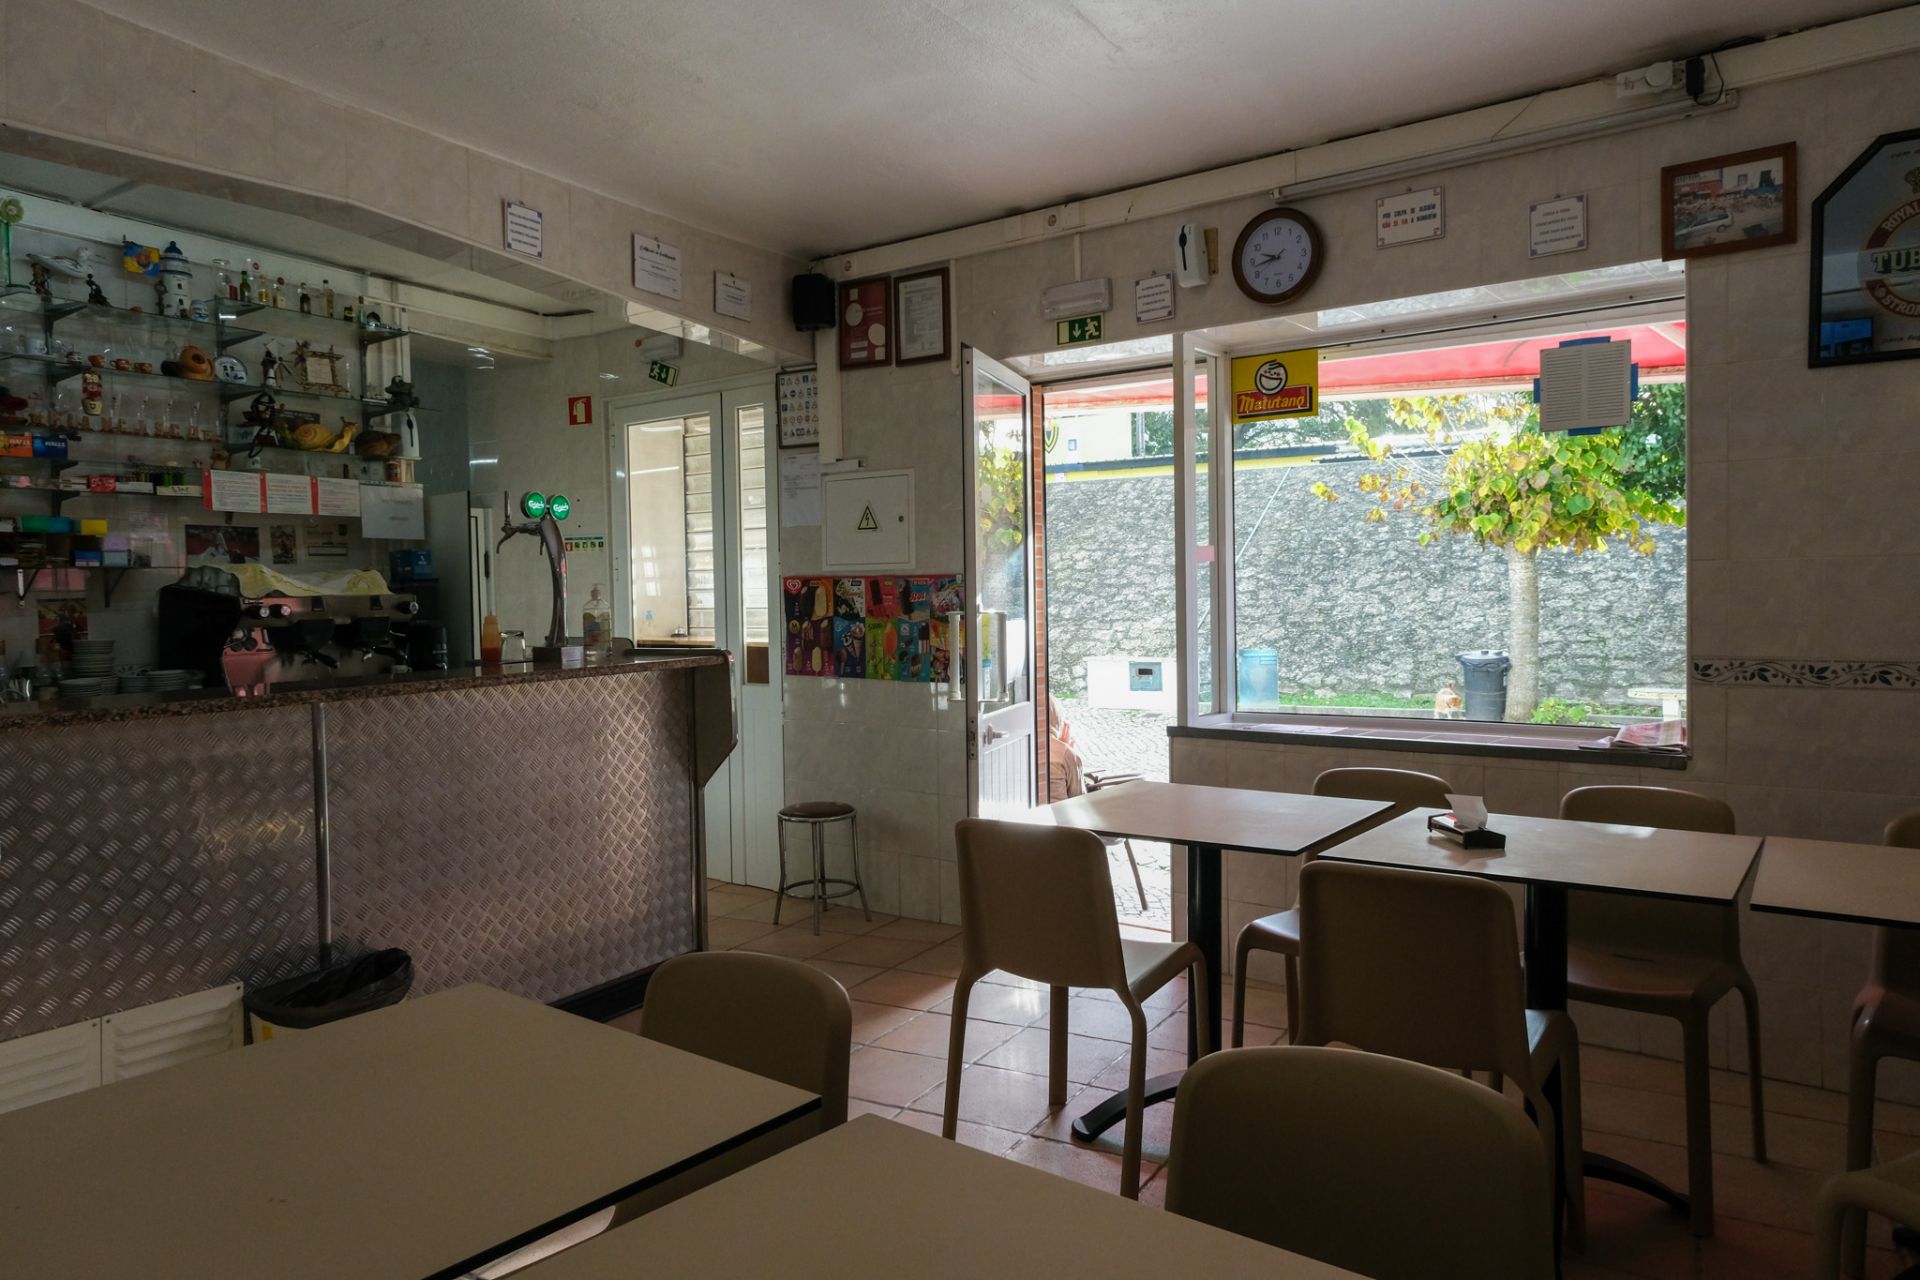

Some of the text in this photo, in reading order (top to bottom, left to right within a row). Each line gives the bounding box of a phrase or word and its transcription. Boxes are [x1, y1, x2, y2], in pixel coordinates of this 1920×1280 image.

[1881, 201, 1920, 231] ROYAL
[1273, 226, 1282, 236] 12
[1262, 232, 1269, 241] 11
[1296, 235, 1302, 244] 2
[1254, 243, 1262, 252] 10
[1301, 248, 1307, 257] 3
[1873, 249, 1920, 272] TUB
[1297, 262, 1303, 270] 4
[1254, 270, 1260, 279] 8
[1288, 273, 1294, 282] 5
[1264, 277, 1270, 286] 7
[1276, 279, 1282, 288] 6
[1239, 395, 1305, 413] Matutano
